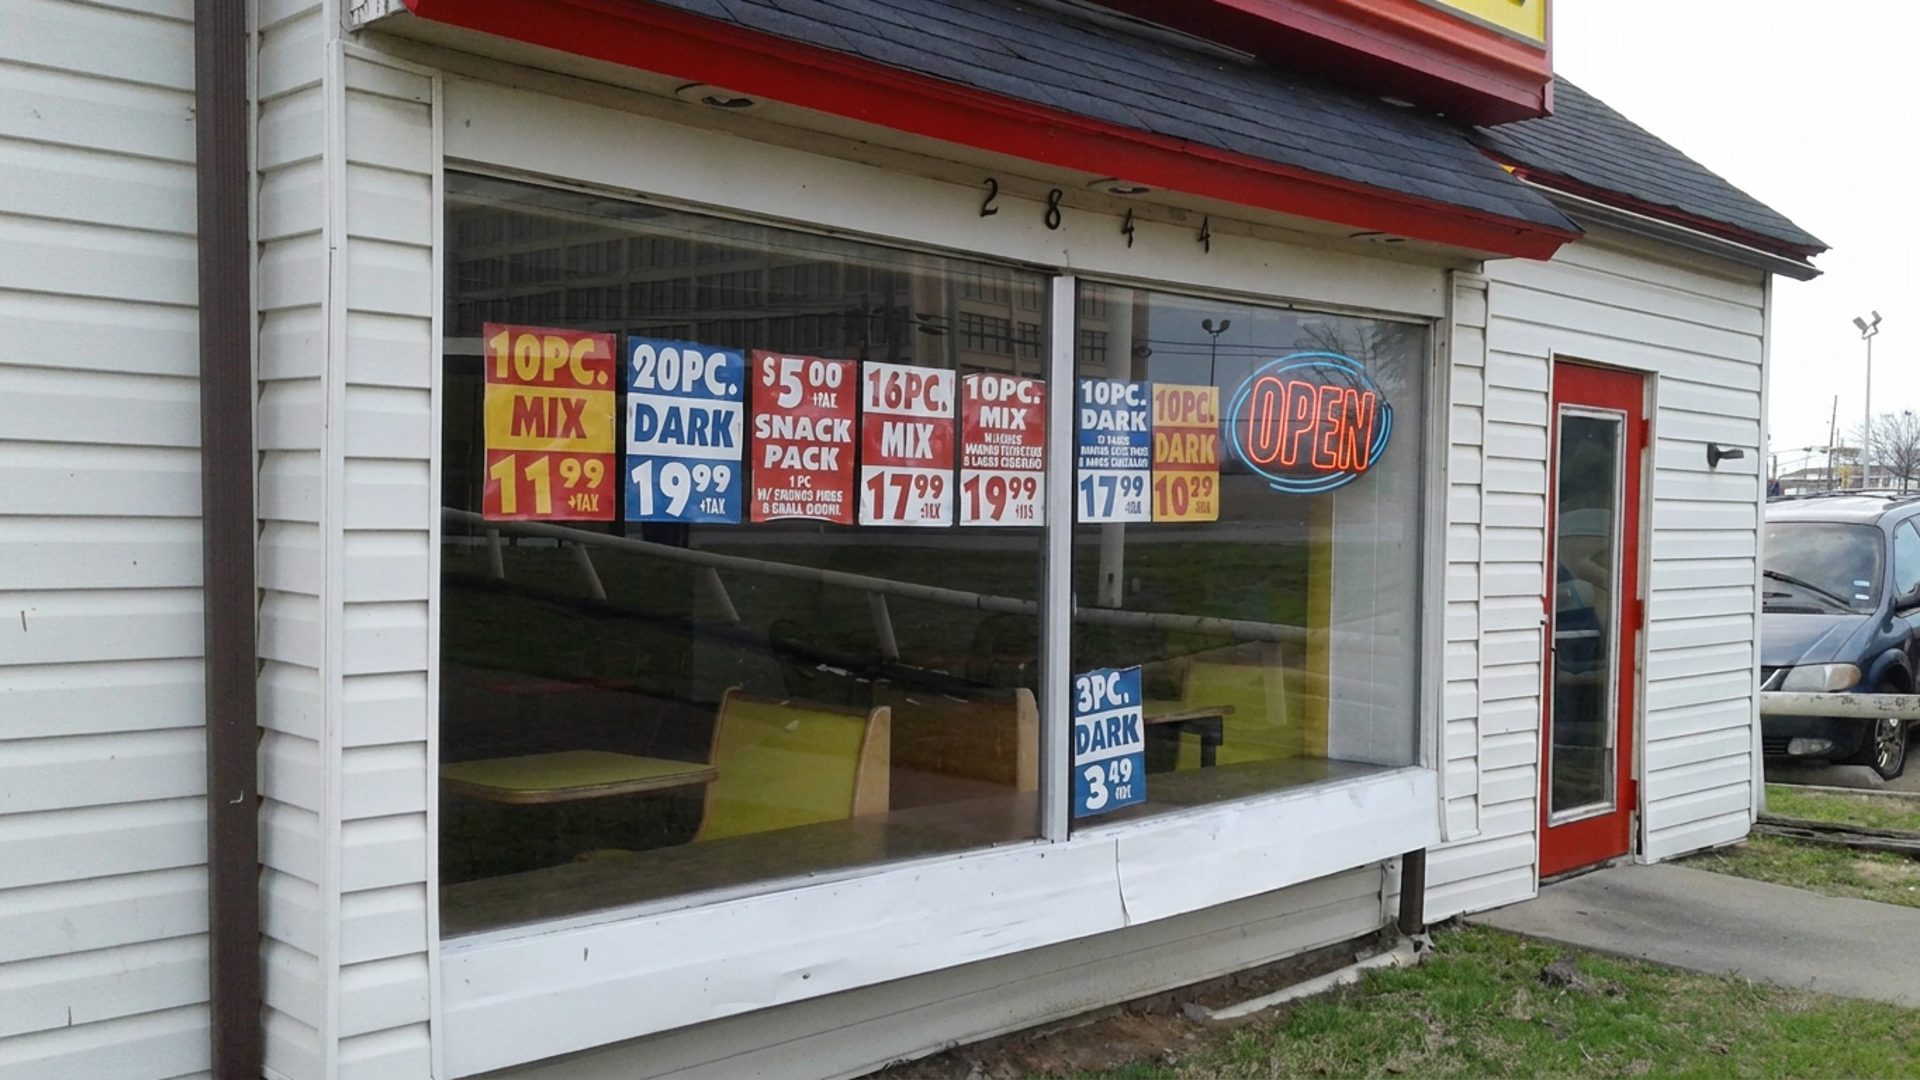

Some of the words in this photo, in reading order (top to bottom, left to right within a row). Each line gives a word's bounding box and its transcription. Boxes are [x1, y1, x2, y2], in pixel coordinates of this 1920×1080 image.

[489, 330, 609, 386] 10PC.
[632, 343, 738, 397] 20PC.
[868, 367, 948, 413] 16PC.
[966, 375, 1041, 405] 10PC.
[1081, 379, 1148, 407] 10PC.
[1155, 389, 1215, 423] 10PC.
[510, 394, 588, 440] MIX
[634, 402, 735, 448] DARK
[754, 412, 852, 443] SNACK
[979, 405, 1028, 431] MIX
[1081, 408, 1148, 432] DARK
[1248, 376, 1376, 471] OPEN
[763, 443, 840, 471] PACK
[881, 420, 935, 460] MIX
[1155, 431, 1216, 465] DARK
[1076, 671, 1130, 713] 3PC.
[1076, 712, 1141, 756] DARK
